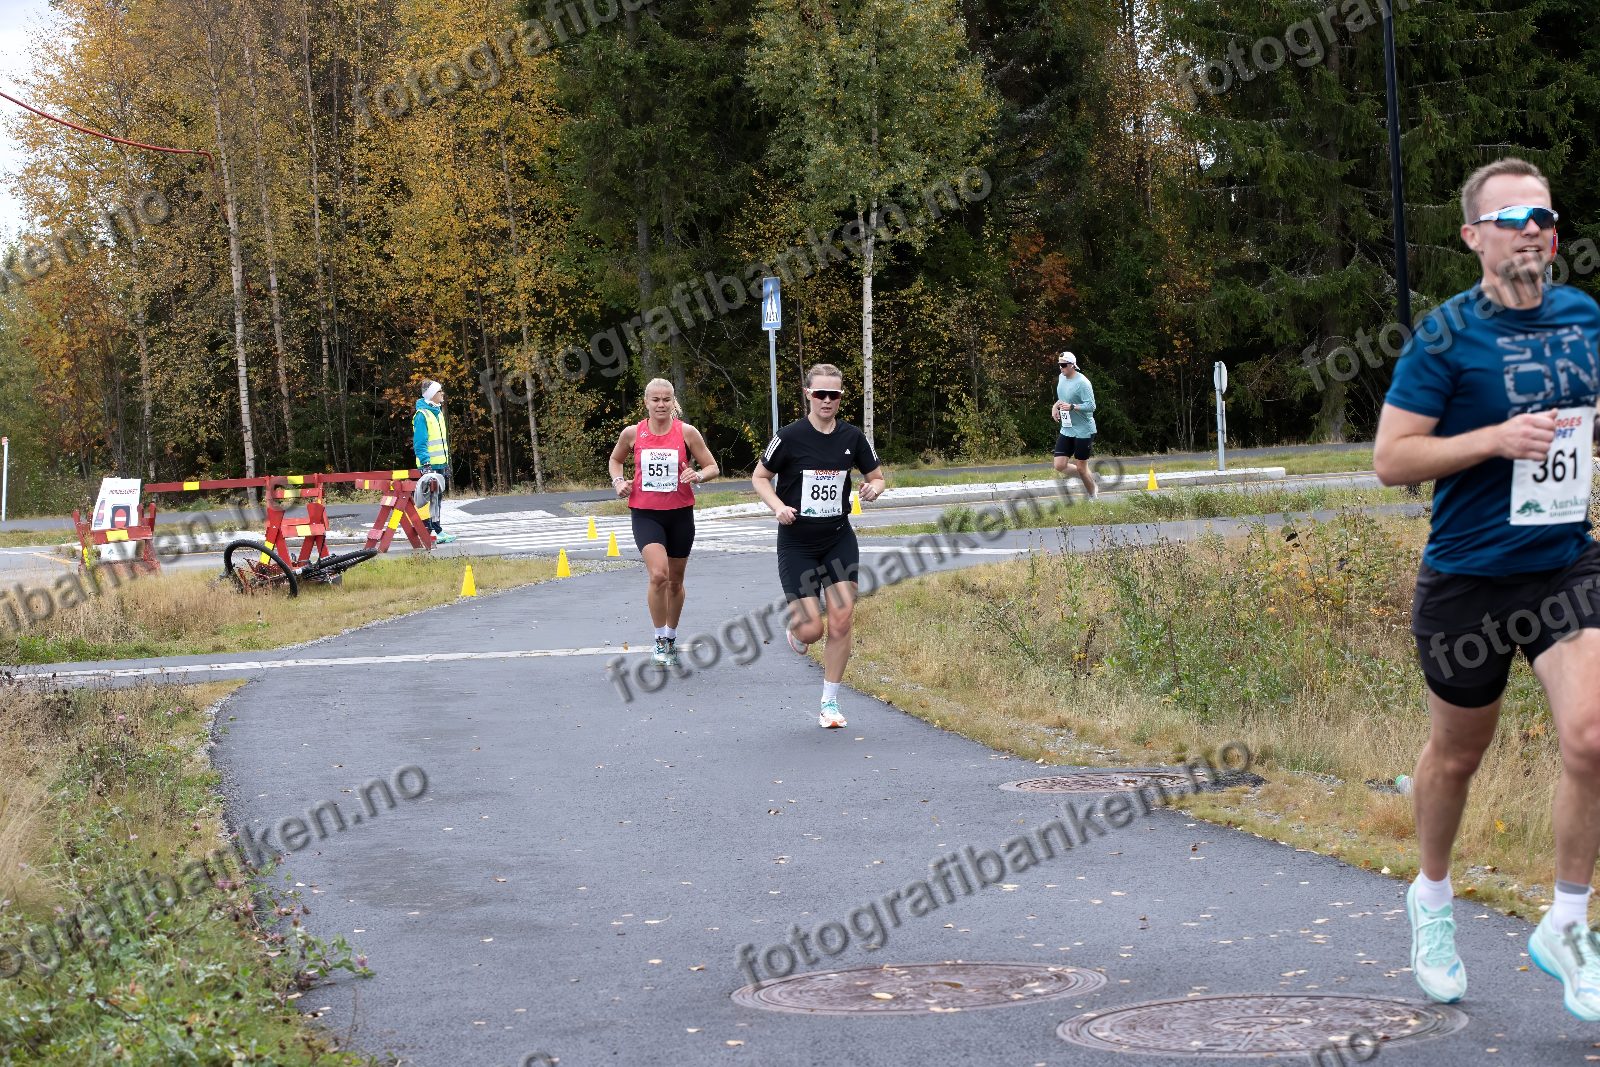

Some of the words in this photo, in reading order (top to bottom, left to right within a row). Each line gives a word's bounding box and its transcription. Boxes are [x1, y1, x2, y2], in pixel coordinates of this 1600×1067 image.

[648, 463, 669, 477] 551
[1532, 447, 1578, 483] 361
[811, 484, 838, 501] 856
